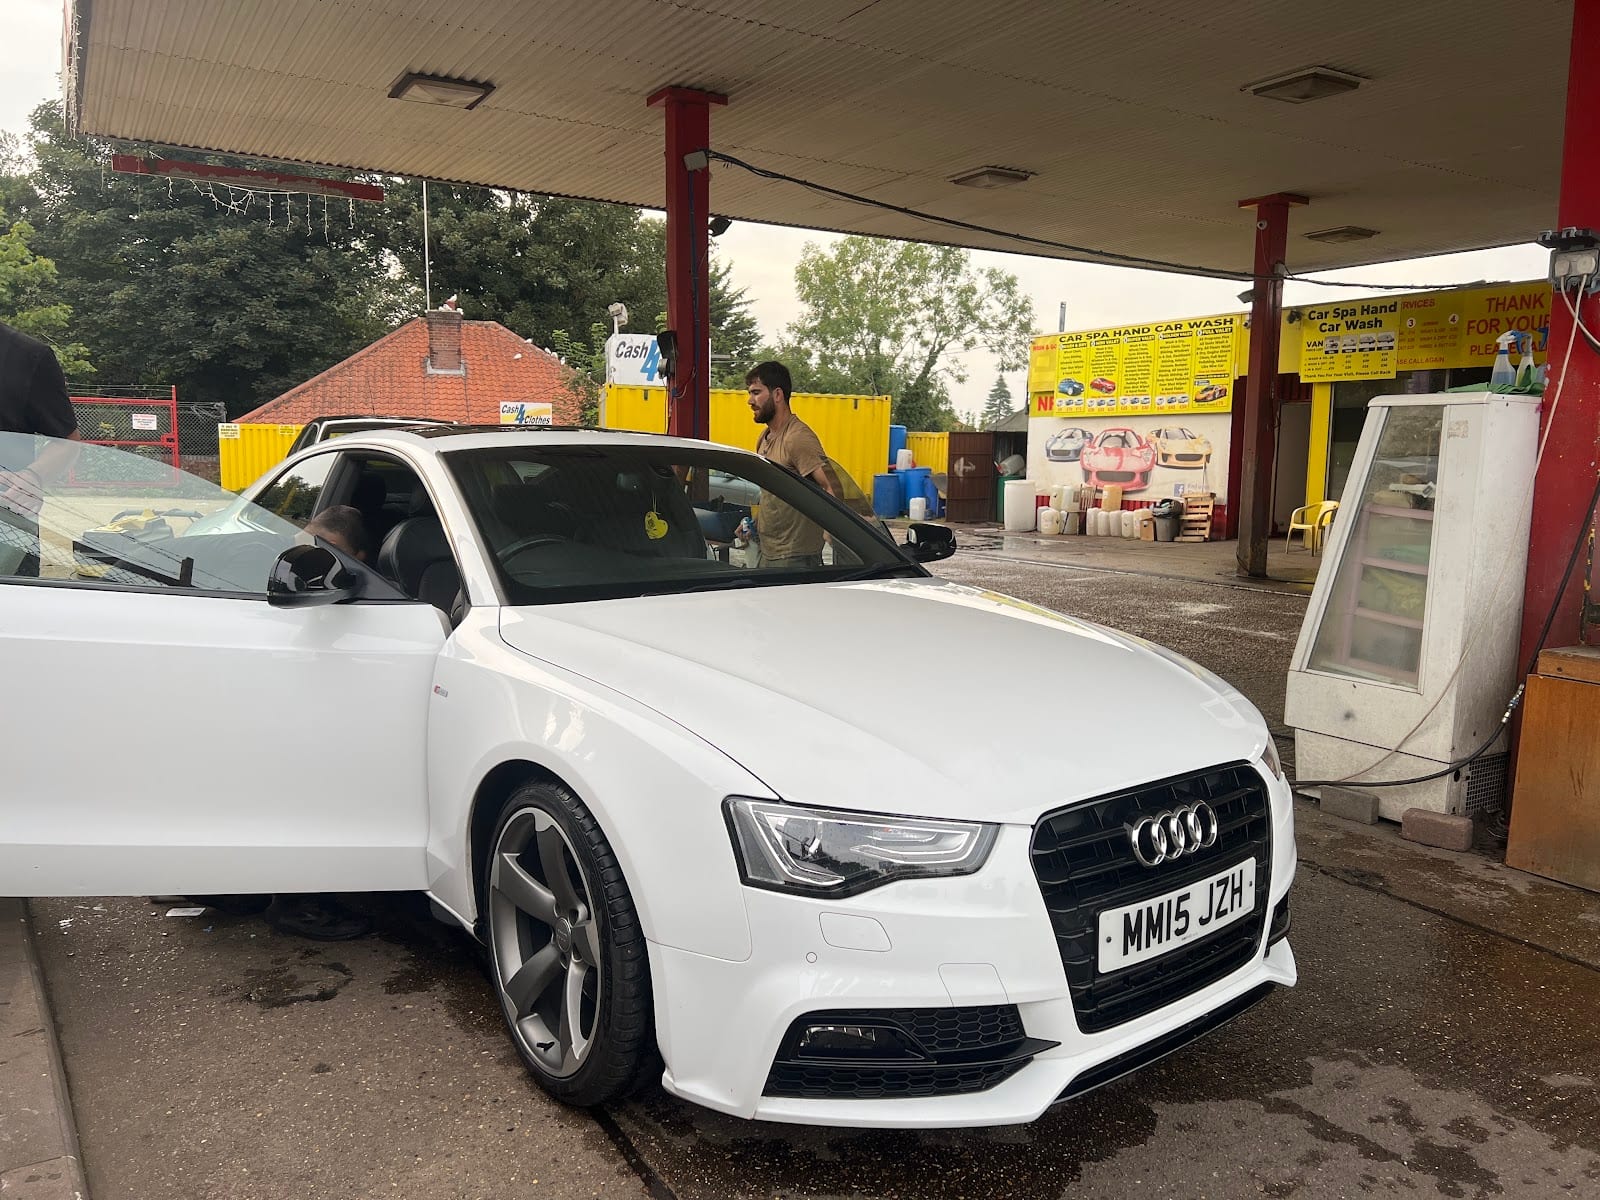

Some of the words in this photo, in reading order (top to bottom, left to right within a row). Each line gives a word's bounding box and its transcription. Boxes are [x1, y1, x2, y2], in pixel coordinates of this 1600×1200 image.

[1308, 310, 1329, 320] Car
[1333, 308, 1357, 320] Spa
[1361, 301, 1397, 316] Hand
[1401, 299, 1435, 310] RVICES
[1486, 293, 1545, 313] THANK
[1319, 322, 1340, 333] Car
[1345, 317, 1383, 331] Wash
[1408, 319, 1414, 327] 3
[1450, 315, 1457, 323] 4
[1467, 318, 1500, 335] FOR
[1059, 335, 1083, 343] CAR
[1086, 332, 1110, 340] SPA
[1113, 327, 1151, 337] HAND
[1155, 323, 1183, 333] CAR
[1188, 318, 1234, 329] WASH
[1306, 340, 1324, 348] VAN
[1470, 342, 1516, 355] PLEAE
[615, 341, 649, 359] Cash
[640, 339, 660, 381] 4
[501, 404, 519, 414] Cash
[515, 403, 525, 424] 4
[524, 415, 551, 425] Clothes
[1122, 892, 1191, 957] MM15
[1198, 869, 1243, 926] JZH
